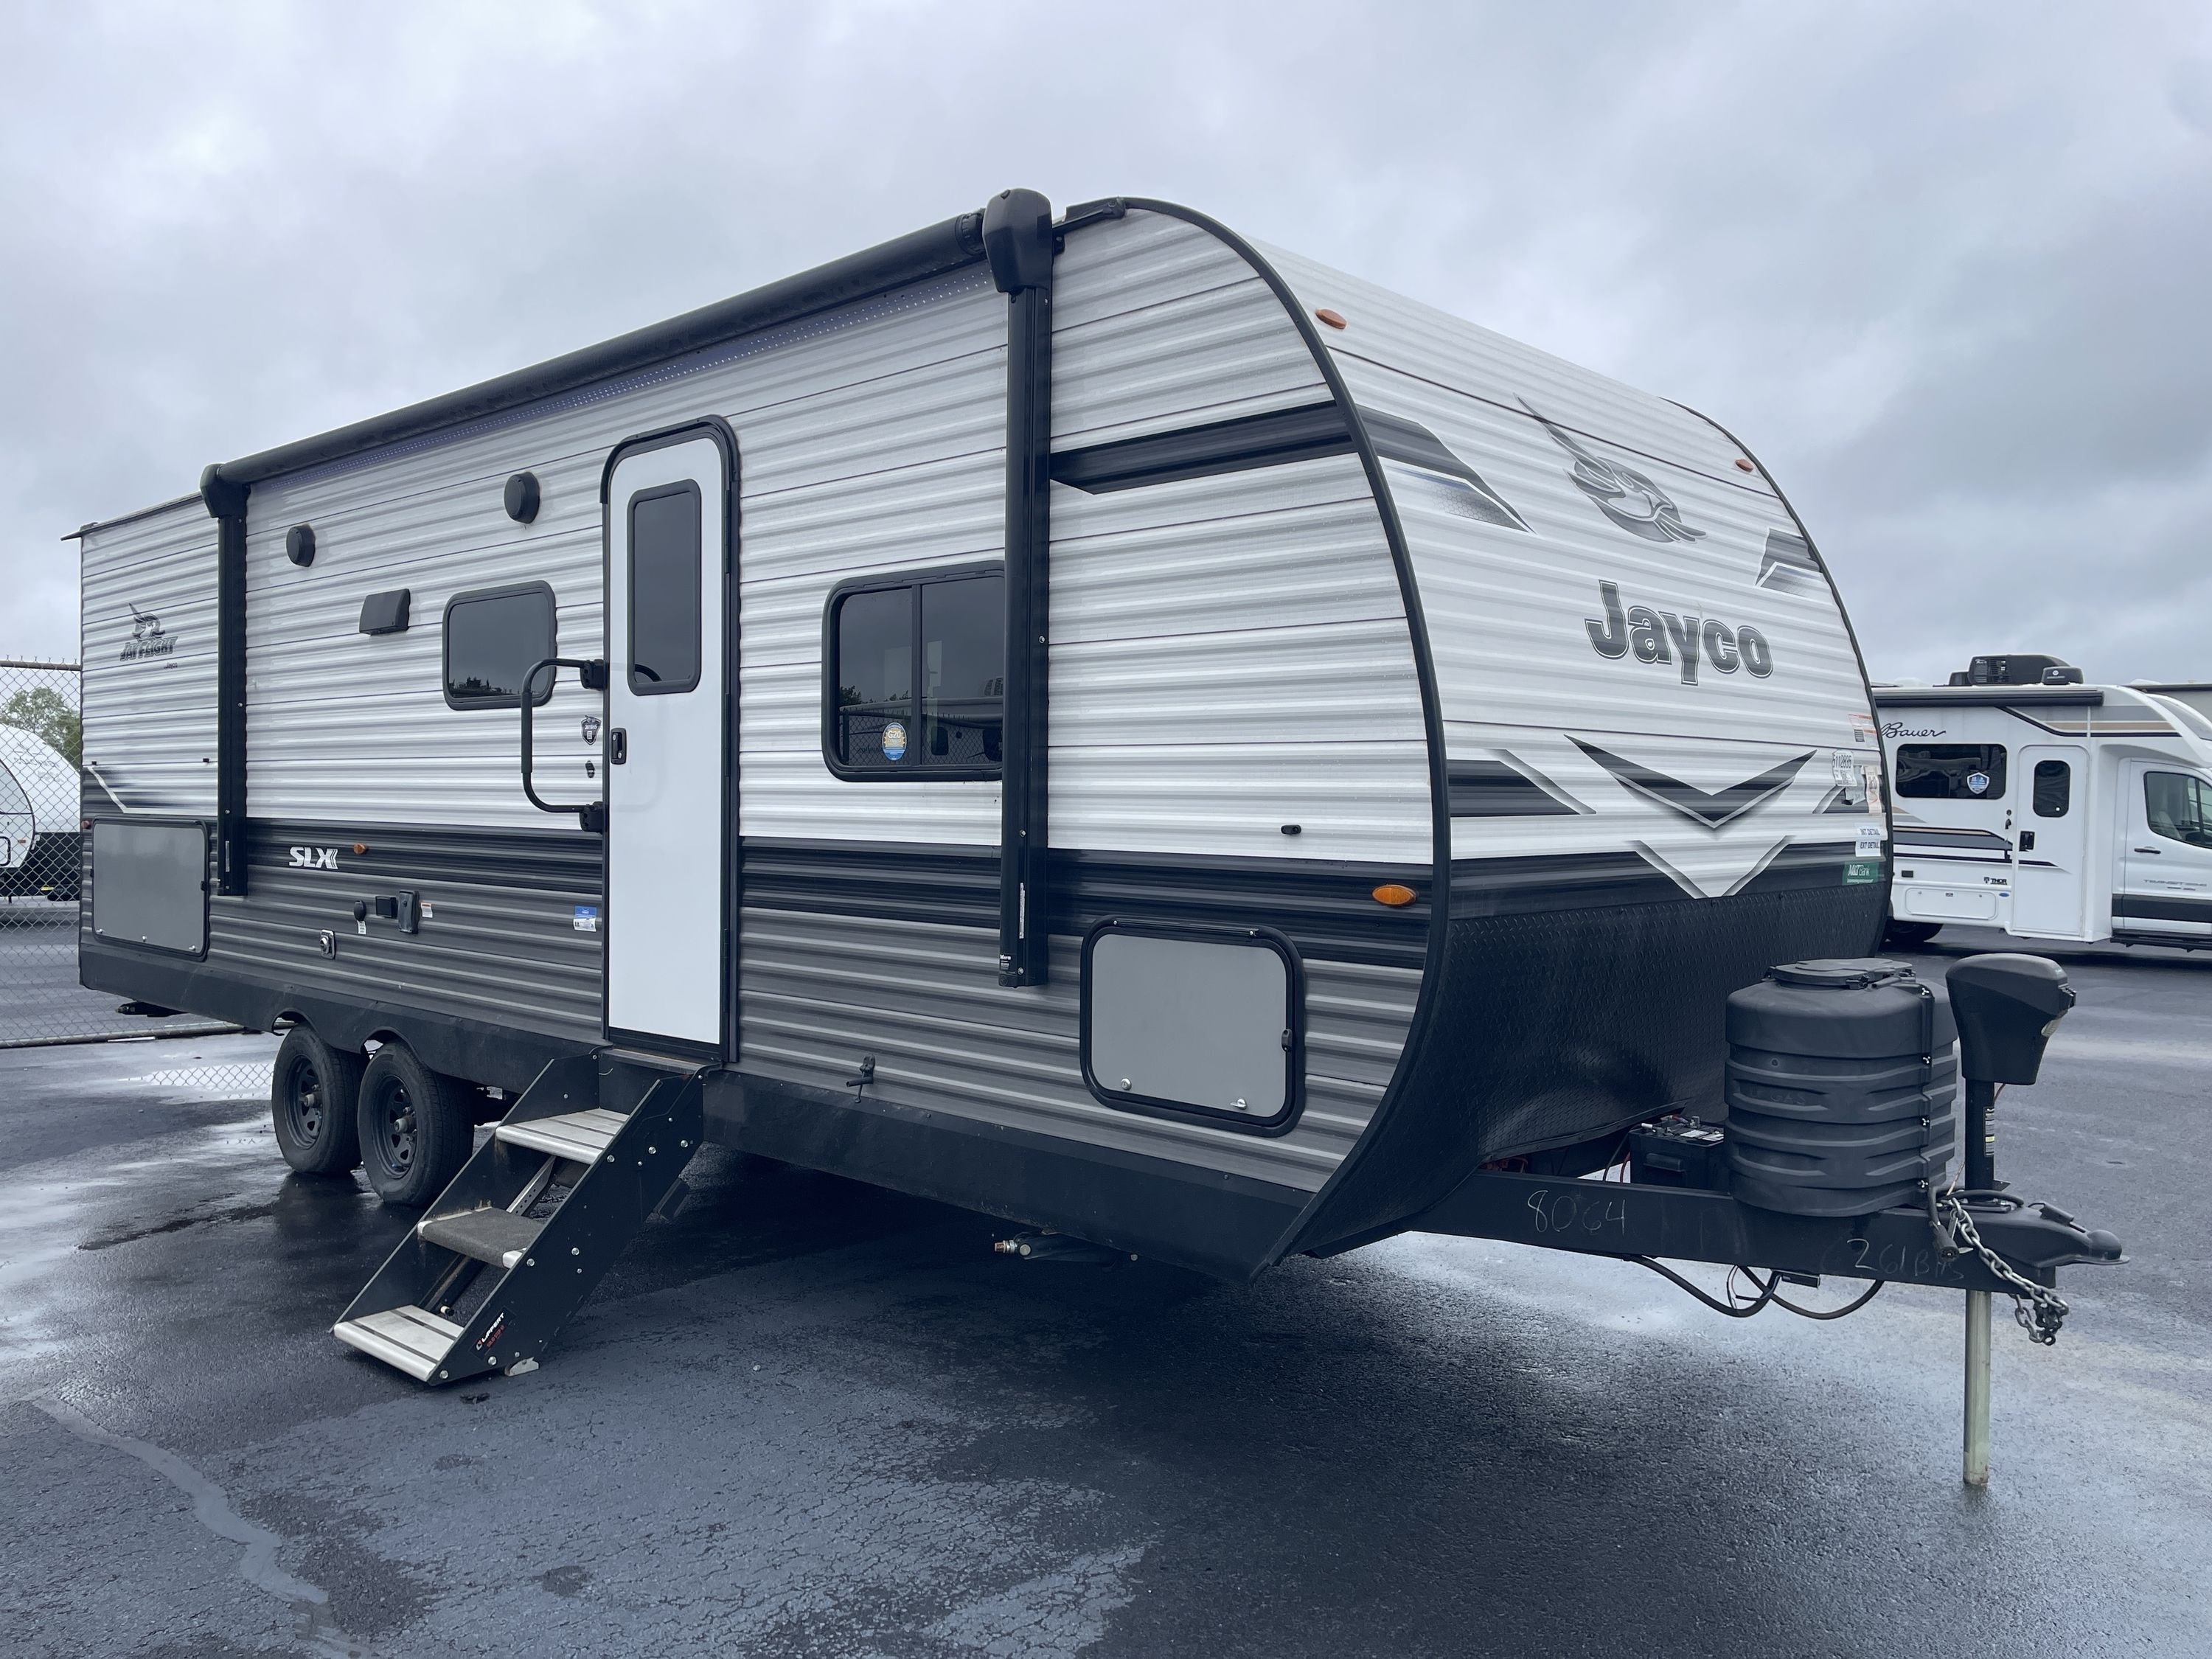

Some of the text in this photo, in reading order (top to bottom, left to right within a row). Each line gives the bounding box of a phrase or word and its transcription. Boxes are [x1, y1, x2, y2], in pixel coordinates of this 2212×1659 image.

[1585, 579, 1773, 686] Jayco
[888, 730, 901, 739] G20
[1881, 722, 1947, 738] Bauer
[289, 846, 338, 869] SLX
[1859, 865, 1871, 876] Bank
[1990, 877, 2008, 886] THOR
[1527, 1189, 1626, 1237] 8064
[481, 1312, 504, 1343] LIPPERT
